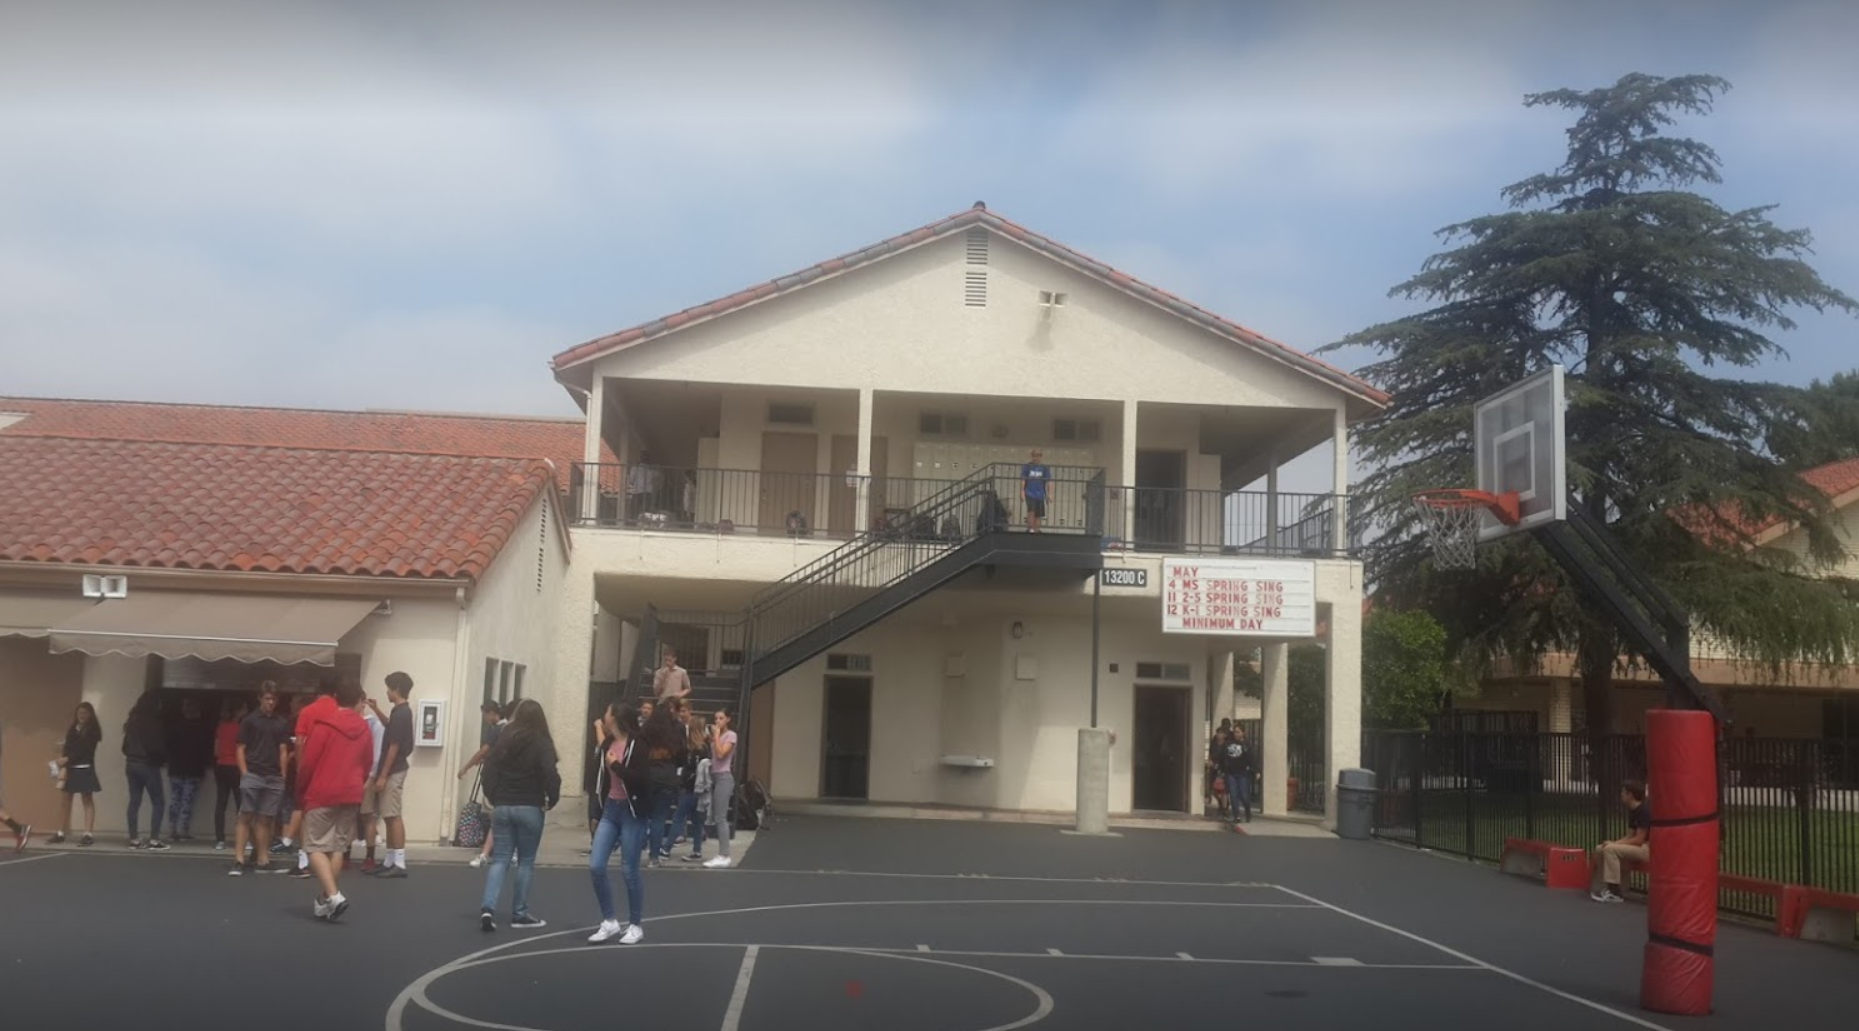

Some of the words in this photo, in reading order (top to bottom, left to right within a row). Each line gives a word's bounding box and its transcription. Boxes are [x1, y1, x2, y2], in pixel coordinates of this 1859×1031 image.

[1104, 570, 1135, 584] 13200
[1138, 571, 1145, 584] C
[1173, 566, 1199, 577] MAY
[1168, 579, 1176, 588] 4
[1182, 579, 1199, 590] MS
[1206, 580, 1248, 591] SPRING
[1256, 581, 1283, 592] SING
[1168, 592, 1176, 602] 11
[1182, 592, 1200, 603] 2-5
[1206, 593, 1248, 604] SPRING
[1256, 594, 1283, 605] SING
[1167, 604, 1177, 615] 12
[1206, 605, 1248, 617] SPRING
[1254, 606, 1281, 617] SING
[1182, 617, 1235, 629] MINIMUM
[1240, 619, 1263, 630] DAY
